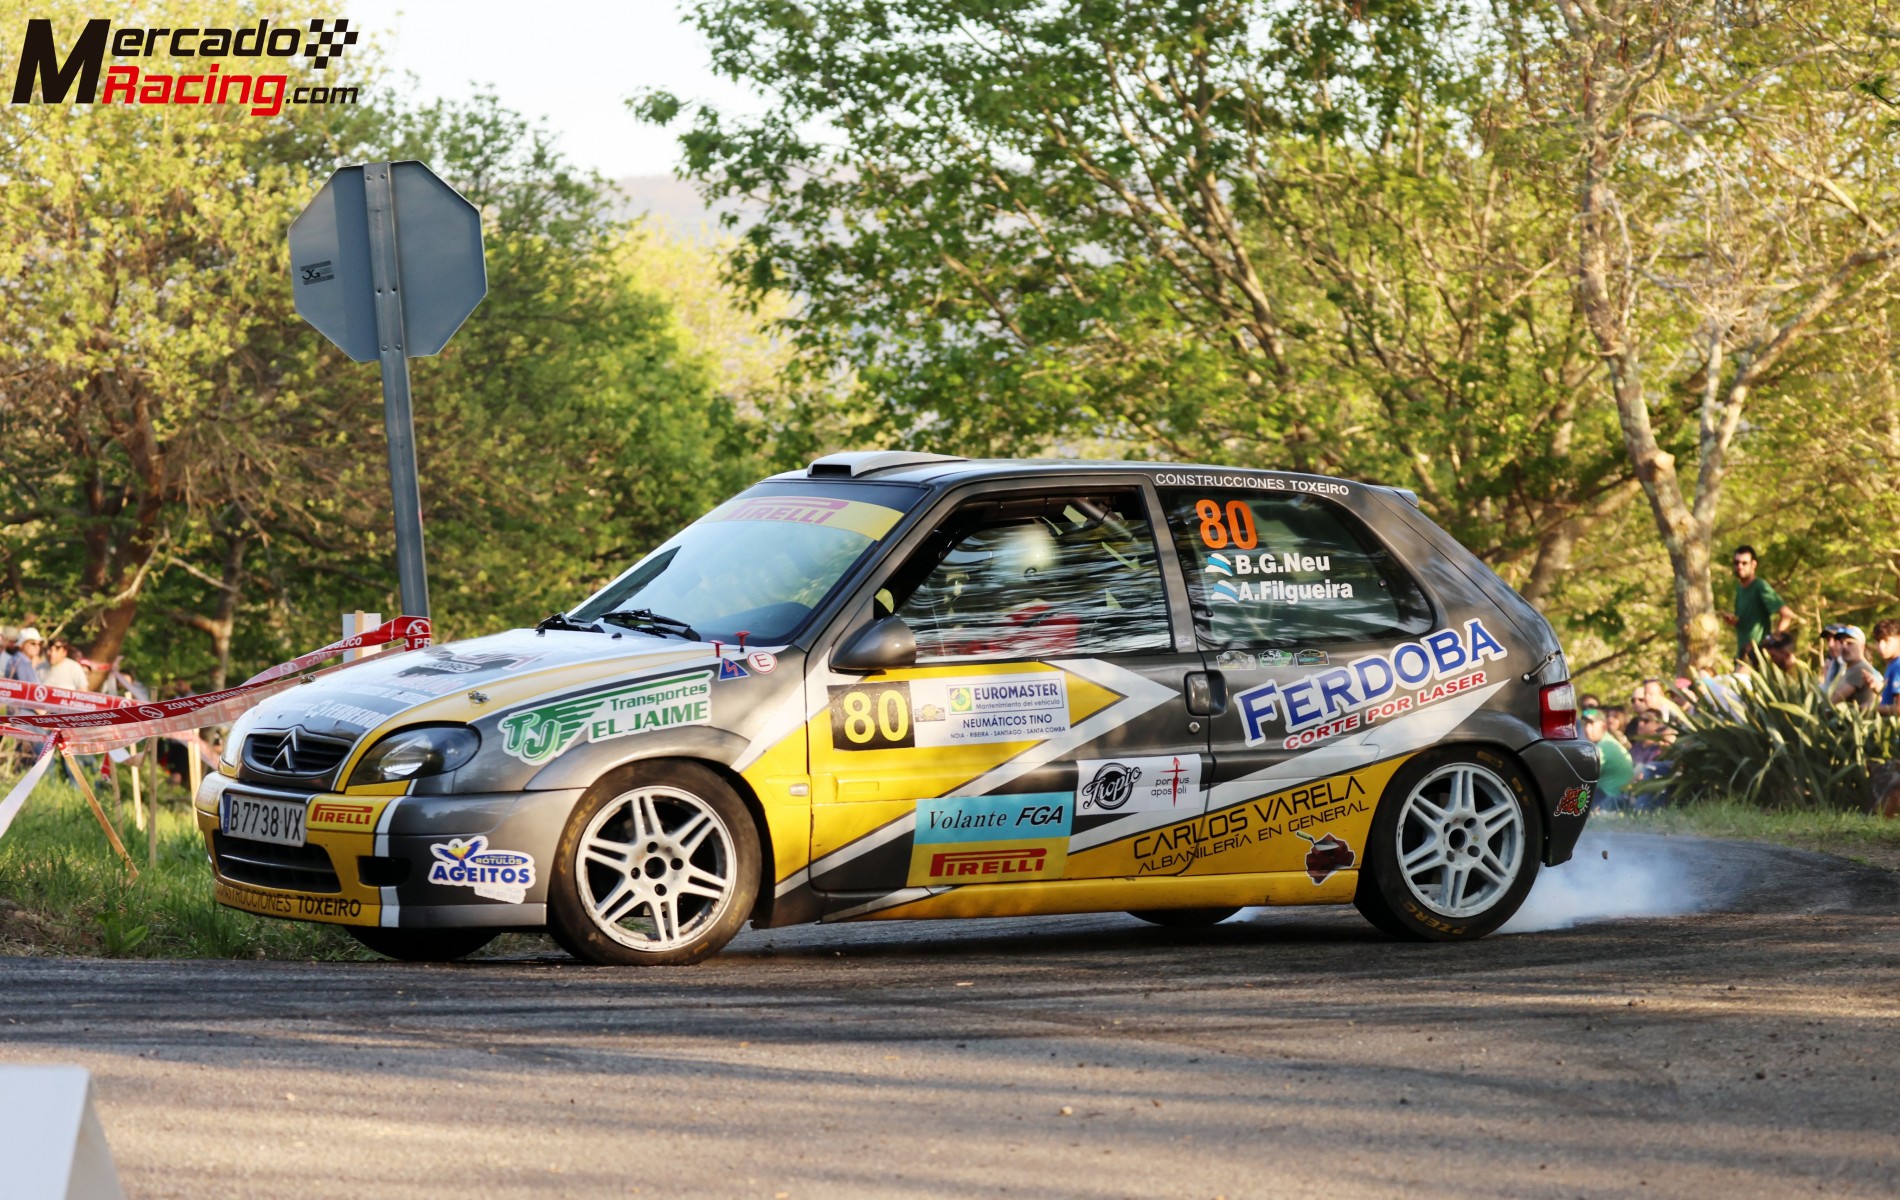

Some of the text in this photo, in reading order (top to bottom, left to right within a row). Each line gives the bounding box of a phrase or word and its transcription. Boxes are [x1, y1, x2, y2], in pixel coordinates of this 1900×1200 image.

[1155, 473, 1349, 496] CONSTRUCCIONES TOXEIRO
[723, 497, 849, 524] PIRELLI
[1195, 499, 1258, 550] 80
[1234, 552, 1331, 575] B.G.Neu
[1238, 578, 1354, 605] A.Filgueira
[754, 653, 771, 668] E
[974, 683, 1059, 701] EUROMASTER
[1238, 620, 1505, 741] FERDOBA
[164, 700, 197, 711] ZONA
[610, 683, 707, 712] Transportes
[976, 701, 1022, 710] Mantenimiento
[1023, 699, 1033, 707] del
[32, 711, 121, 724] ZONA PROHIBIDA
[591, 700, 708, 740] EL JAIME
[843, 689, 909, 744] 80
[963, 713, 1052, 729] NEUMÁTICOS TINO
[1284, 672, 1487, 750] CORTE POR LASER
[993, 729, 1022, 737] SANTIAGO
[1044, 726, 1066, 734] COMBA
[311, 803, 374, 825] PIRELLI
[929, 805, 1064, 830] Volante FGA
[1133, 776, 1366, 860] CARLOS VARELA
[1138, 800, 1370, 874] ALBAÑILERÍA EN GENERAL
[432, 865, 530, 884] AGEITOS
[929, 848, 1048, 877] PIRELLI
[295, 896, 362, 918] TOXEIRO
